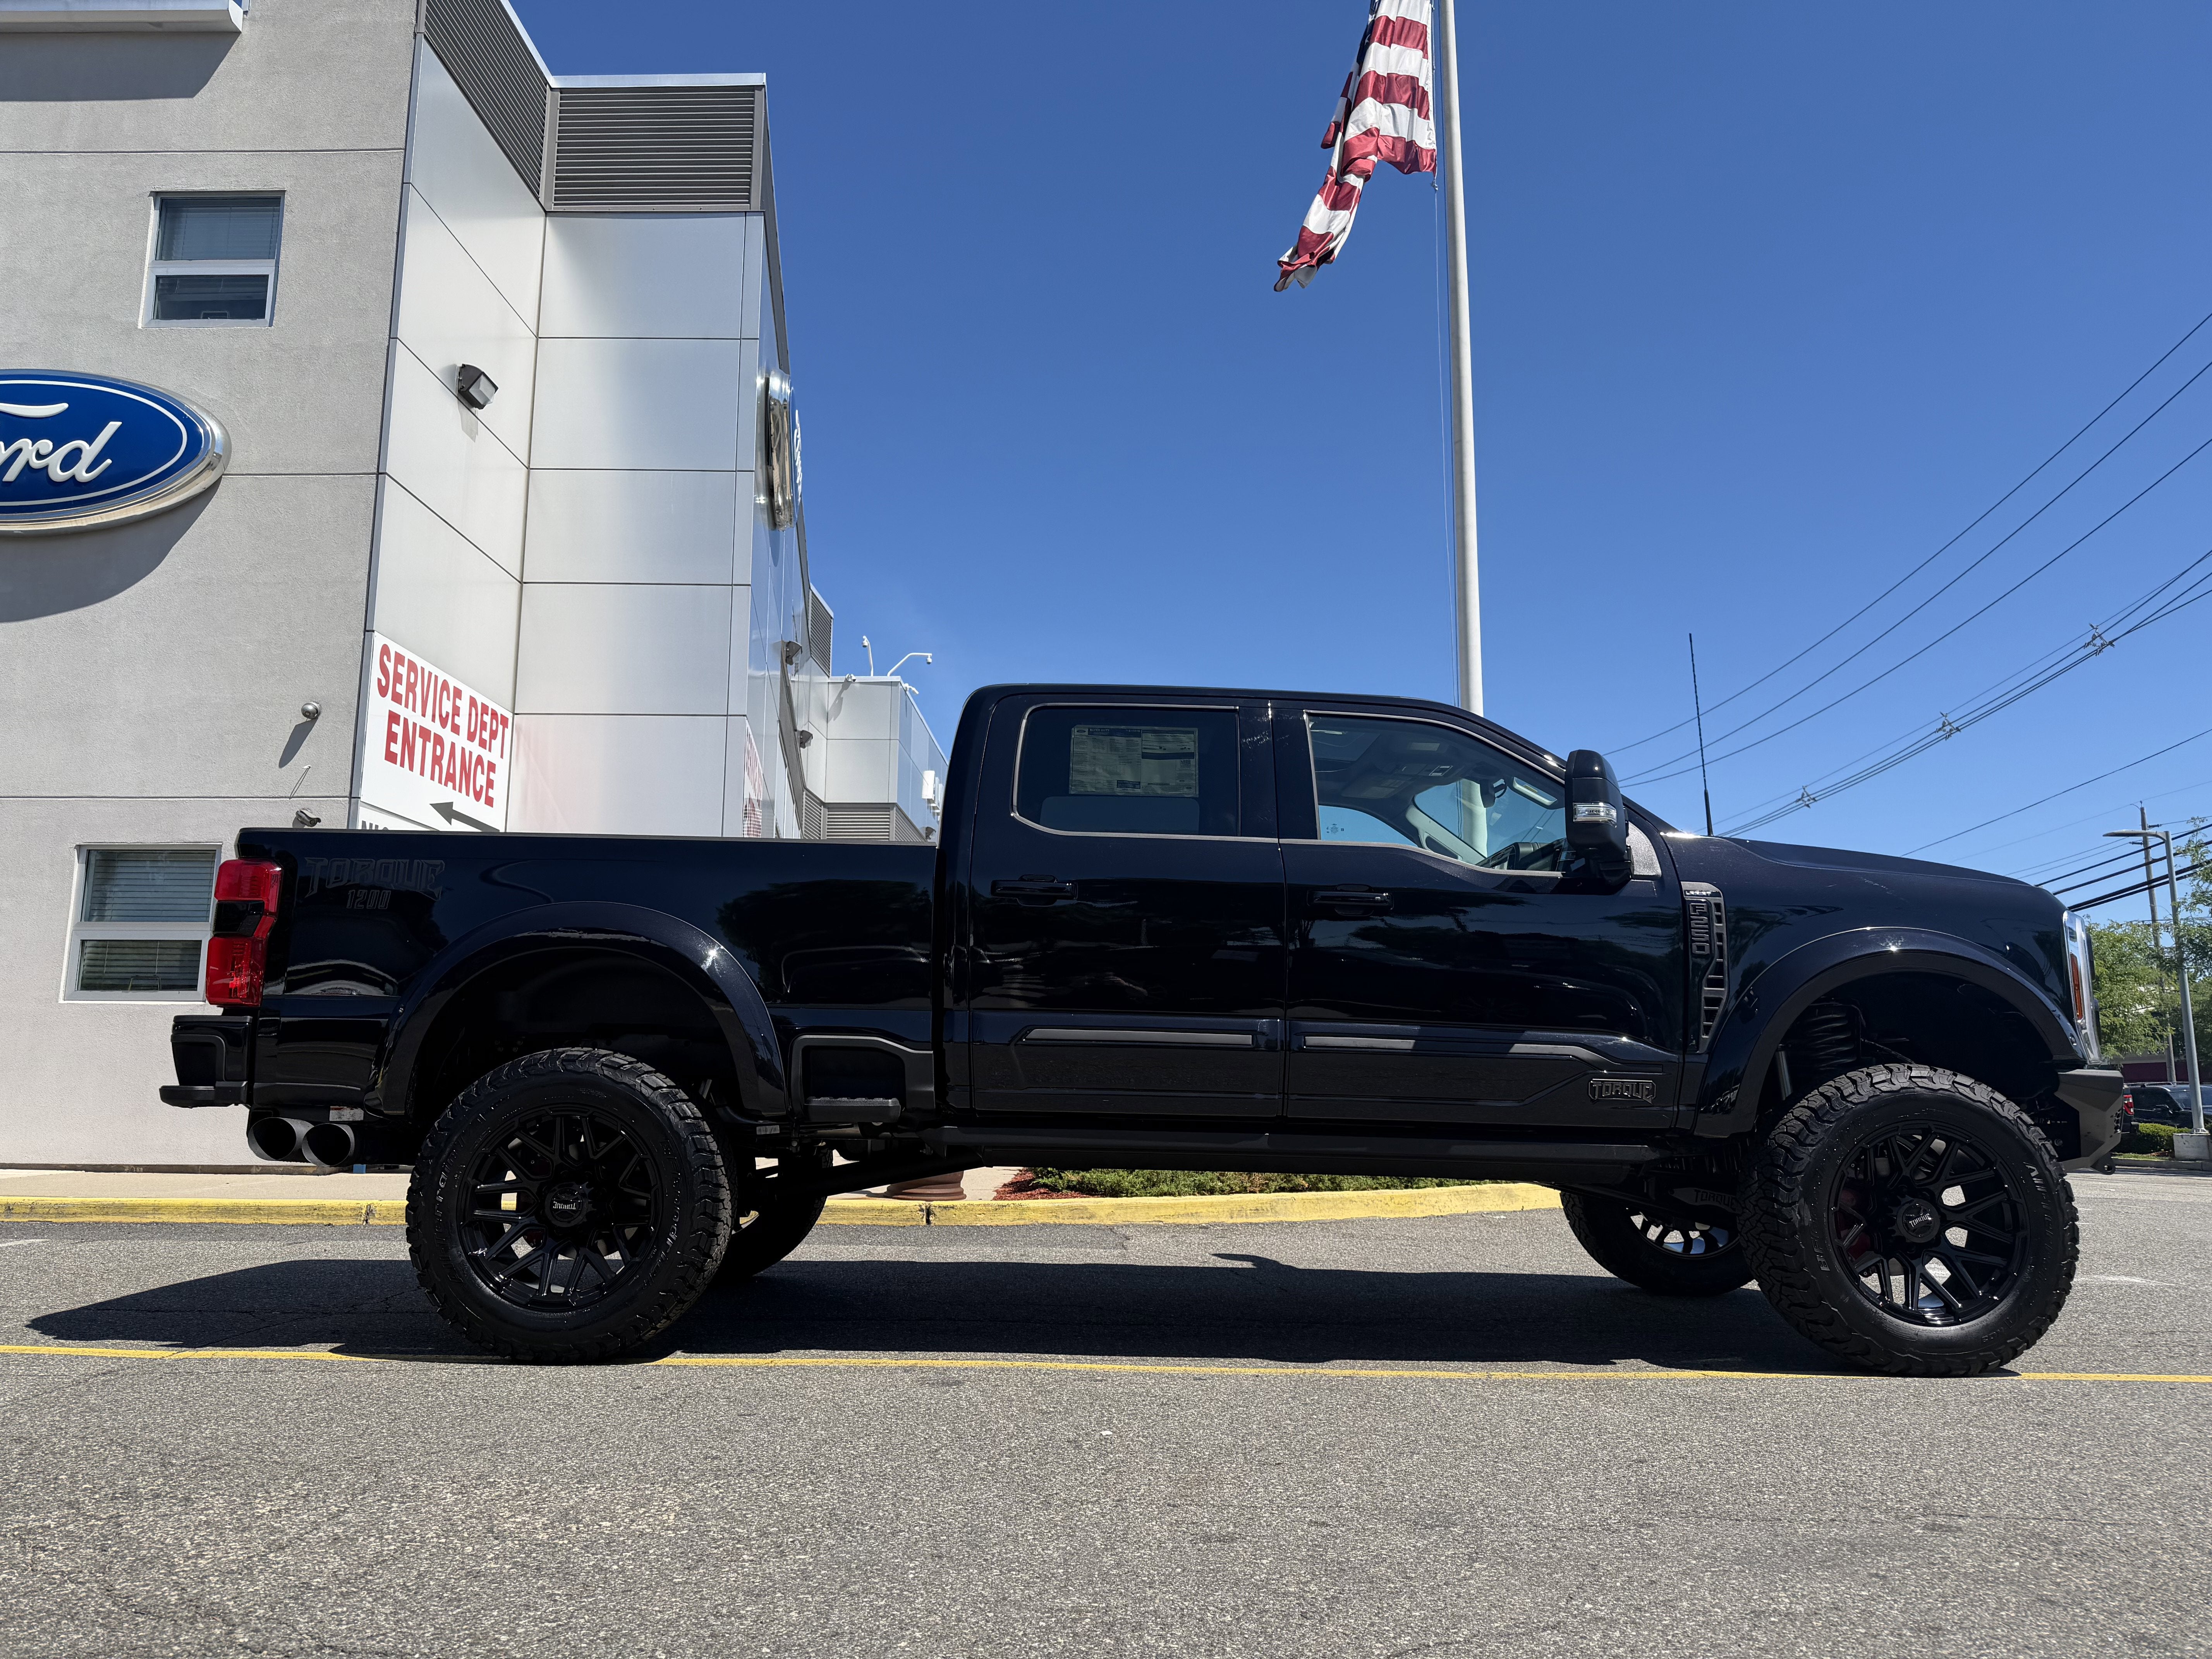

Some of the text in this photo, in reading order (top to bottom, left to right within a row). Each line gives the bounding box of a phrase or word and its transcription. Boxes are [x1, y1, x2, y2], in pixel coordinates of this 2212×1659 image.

[377, 643, 509, 759] SERVICE DEPT
[384, 709, 496, 808] ENTRANCE
[304, 857, 445, 901] TORQUE
[346, 889, 391, 909] 1200
[1591, 1081, 1653, 1104] TORQUE
